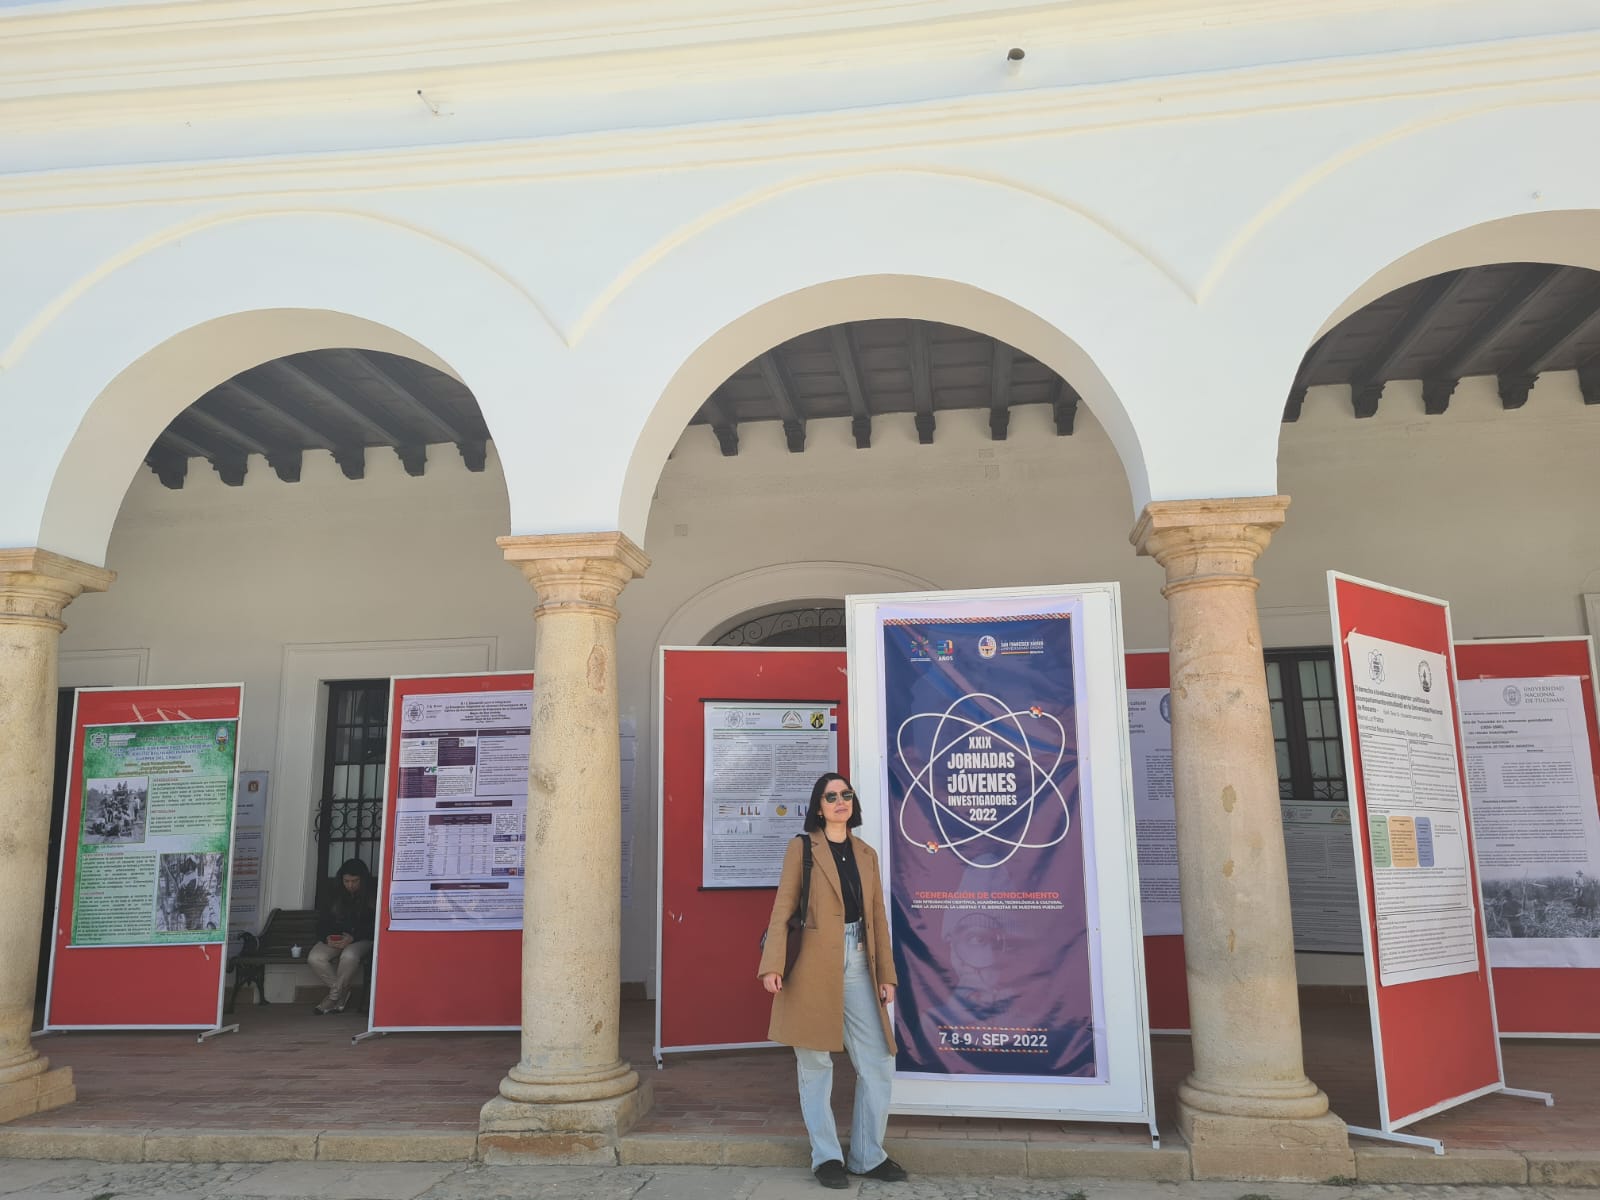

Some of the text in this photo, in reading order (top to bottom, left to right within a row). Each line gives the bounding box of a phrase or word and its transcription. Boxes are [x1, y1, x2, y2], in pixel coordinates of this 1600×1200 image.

[968, 736, 992, 750] XXIX
[947, 752, 1015, 769] JORNADAS
[947, 769, 1017, 793] JÓVENES
[948, 795, 1018, 806] INVESTIGADORES
[969, 808, 997, 821] 2022
[991, 891, 1060, 899] CONOCIMIENTO
[939, 1032, 972, 1045] 7-8-9
[982, 1033, 1009, 1046] SEP
[1013, 1034, 1048, 1047] 2022
